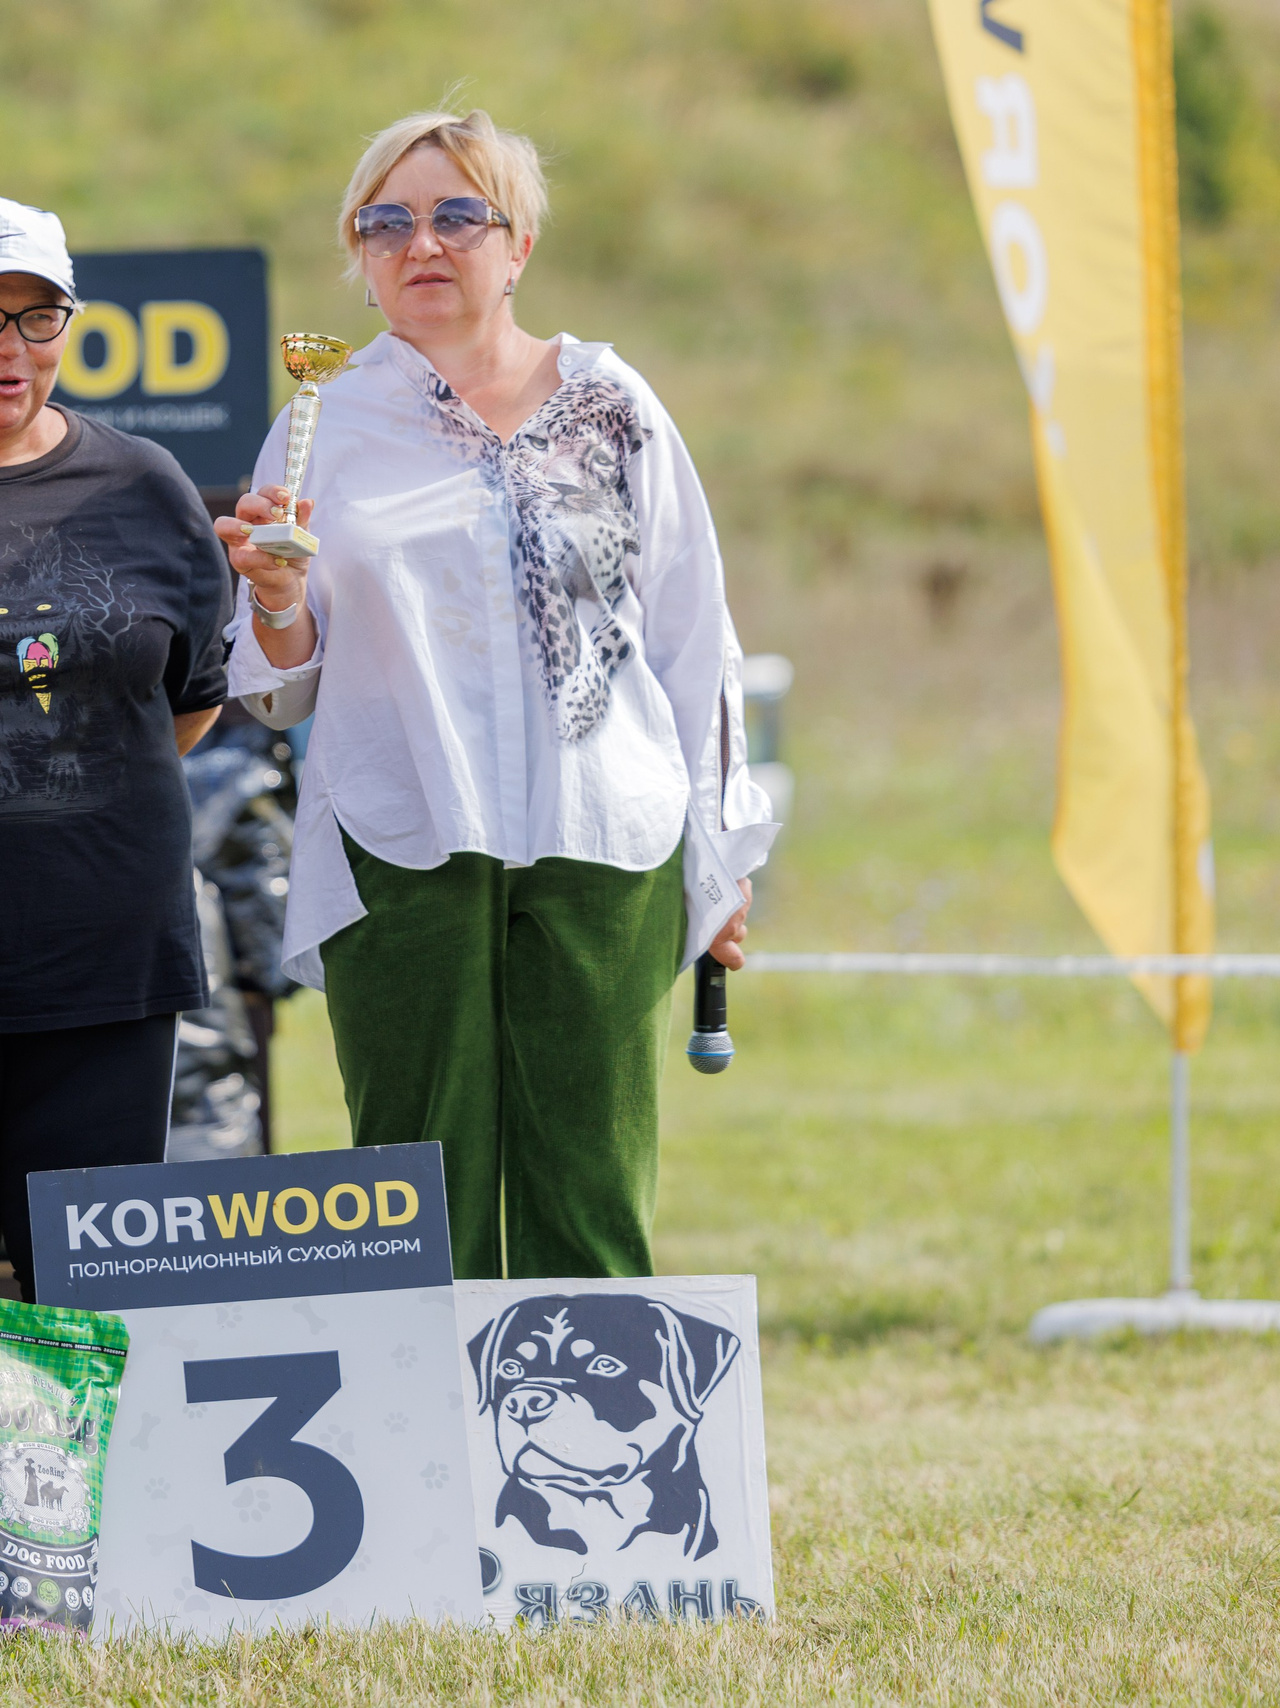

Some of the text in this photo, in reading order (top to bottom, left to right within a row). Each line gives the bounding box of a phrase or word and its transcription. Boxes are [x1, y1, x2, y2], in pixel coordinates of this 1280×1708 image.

[65, 1179, 420, 1251] KORWOOD
[69, 1237, 421, 1278] ПОЛНОРАЦИОННЫЙ СУХОЙ КОРМ
[24, 1370, 80, 1407] PREMIUM
[37, 1464, 65, 1480] ZooRing
[183, 1350, 364, 1600] 3
[2, 1541, 86, 1571] DOG FOOD
